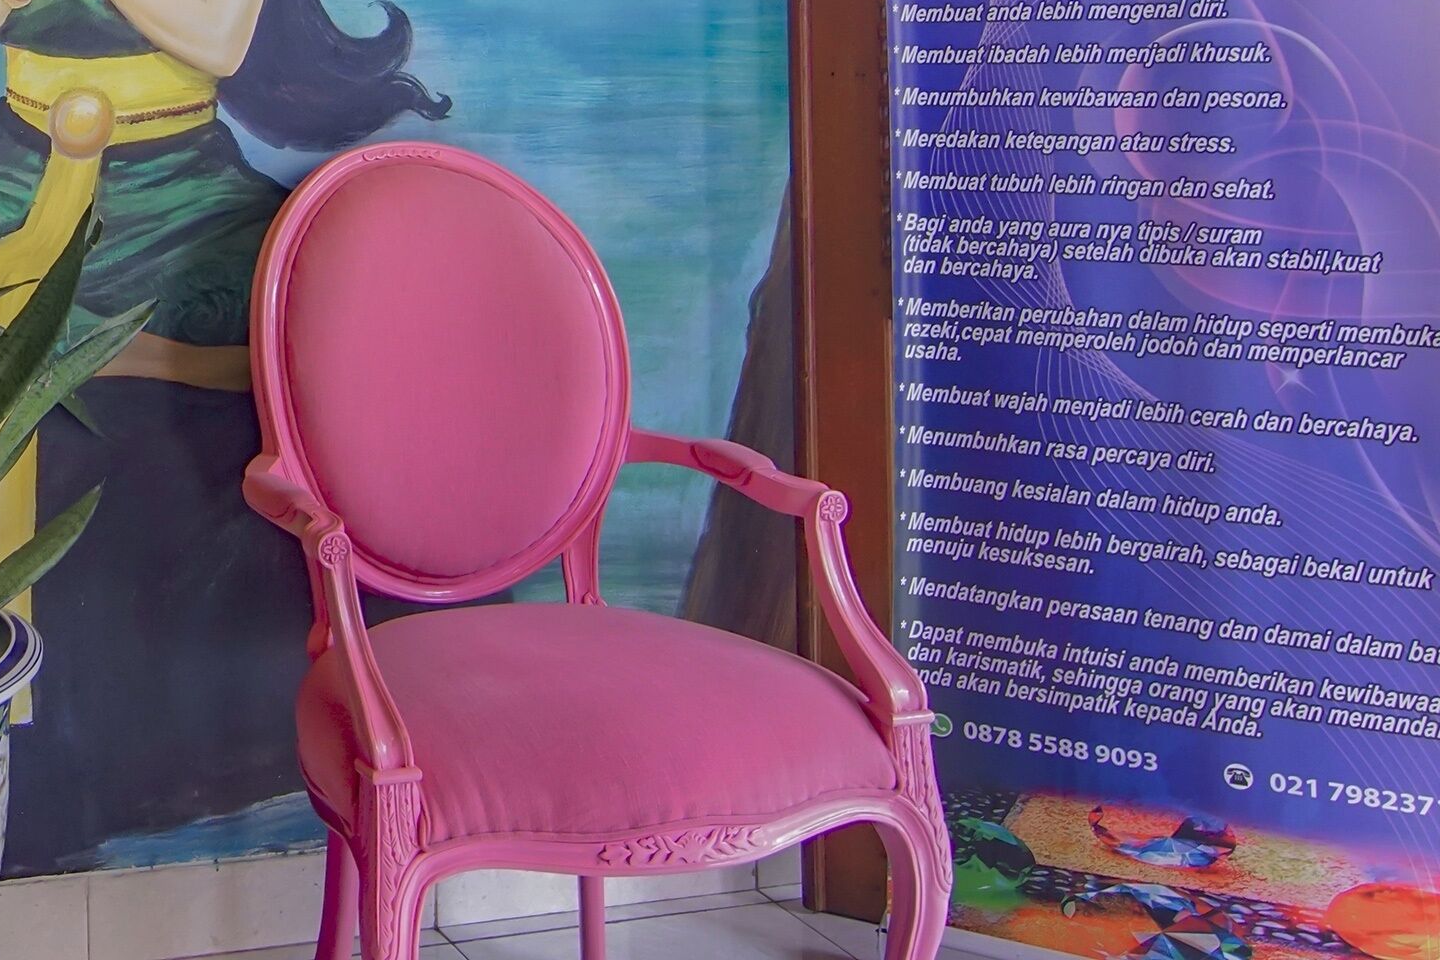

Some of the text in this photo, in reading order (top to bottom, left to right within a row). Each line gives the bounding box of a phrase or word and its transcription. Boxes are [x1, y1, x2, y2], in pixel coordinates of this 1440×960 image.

[901, 3, 983, 23] Membuat
[987, 3, 1032, 22] anda
[1036, 1, 1084, 22] lebih
[1087, 0, 1185, 25] mengenal
[902, 44, 1271, 68] Membuat ibadah lebih menjadi khusuk.
[903, 88, 1288, 112] Menumbuhkan kewibawaan dan pesona.
[903, 129, 1236, 154] Meredakan ketegangan atau stress.
[904, 171, 1275, 200] Membuat tubuh lebih ringan dan sehat.
[905, 213, 947, 236] Bagi
[950, 217, 995, 236] anda
[998, 219, 1043, 241] yang
[1048, 221, 1092, 239] aura
[1096, 225, 1133, 246] nya
[1137, 222, 1182, 243] tipis
[1197, 226, 1263, 245] suram
[904, 236, 954, 256] (tidak
[957, 237, 1060, 263] bercahaya)
[1063, 241, 1135, 264] setelah
[1140, 244, 1207, 266] dibuka
[1212, 248, 1262, 268] akan
[904, 257, 1038, 283] dan bercahaya.
[905, 298, 1440, 349] Memberikan perubahan dalam hidup seperti membuka
[905, 343, 962, 362] usaha.
[1015, 329, 1134, 353] memperoleh
[1136, 334, 1199, 358] jodoh
[1203, 337, 1243, 360] dan
[1248, 343, 1405, 370] memperlancar
[907, 383, 1418, 445] Membuat wajah menjadi lebih cerah dan bercahaya.
[908, 425, 1216, 473] Menumbuhkan rasa percaya diri.
[908, 469, 1283, 527] Membuang kesialan dalam hidup anda.
[907, 536, 1094, 575] menuju kesuksesan.
[908, 512, 1435, 591] Membuat hidup lebih bergairah, sebagai bekal untuk
[909, 577, 1044, 613] Mendatangkan
[1047, 597, 1139, 626] perasaan
[1143, 610, 1213, 640] tenang
[1219, 617, 1259, 644] dan
[1263, 623, 1331, 654] damai
[1335, 635, 1402, 661] dalam
[909, 620, 962, 646] Dapat
[967, 629, 1059, 660] membuka
[1062, 645, 1125, 670] intuisi
[1129, 653, 1179, 677] anda
[1184, 660, 1315, 697] memberikan
[908, 645, 1440, 739] dan karismatik, sehingga orang yang akan memanda
[957, 670, 1003, 695] akan
[1006, 677, 1120, 715] bersimpatik
[1123, 696, 1198, 725] kepada
[1203, 710, 1263, 737] Anda.
[963, 721, 1159, 772] 0878 5588 9093
[1269, 772, 1440, 817] 021 798237
